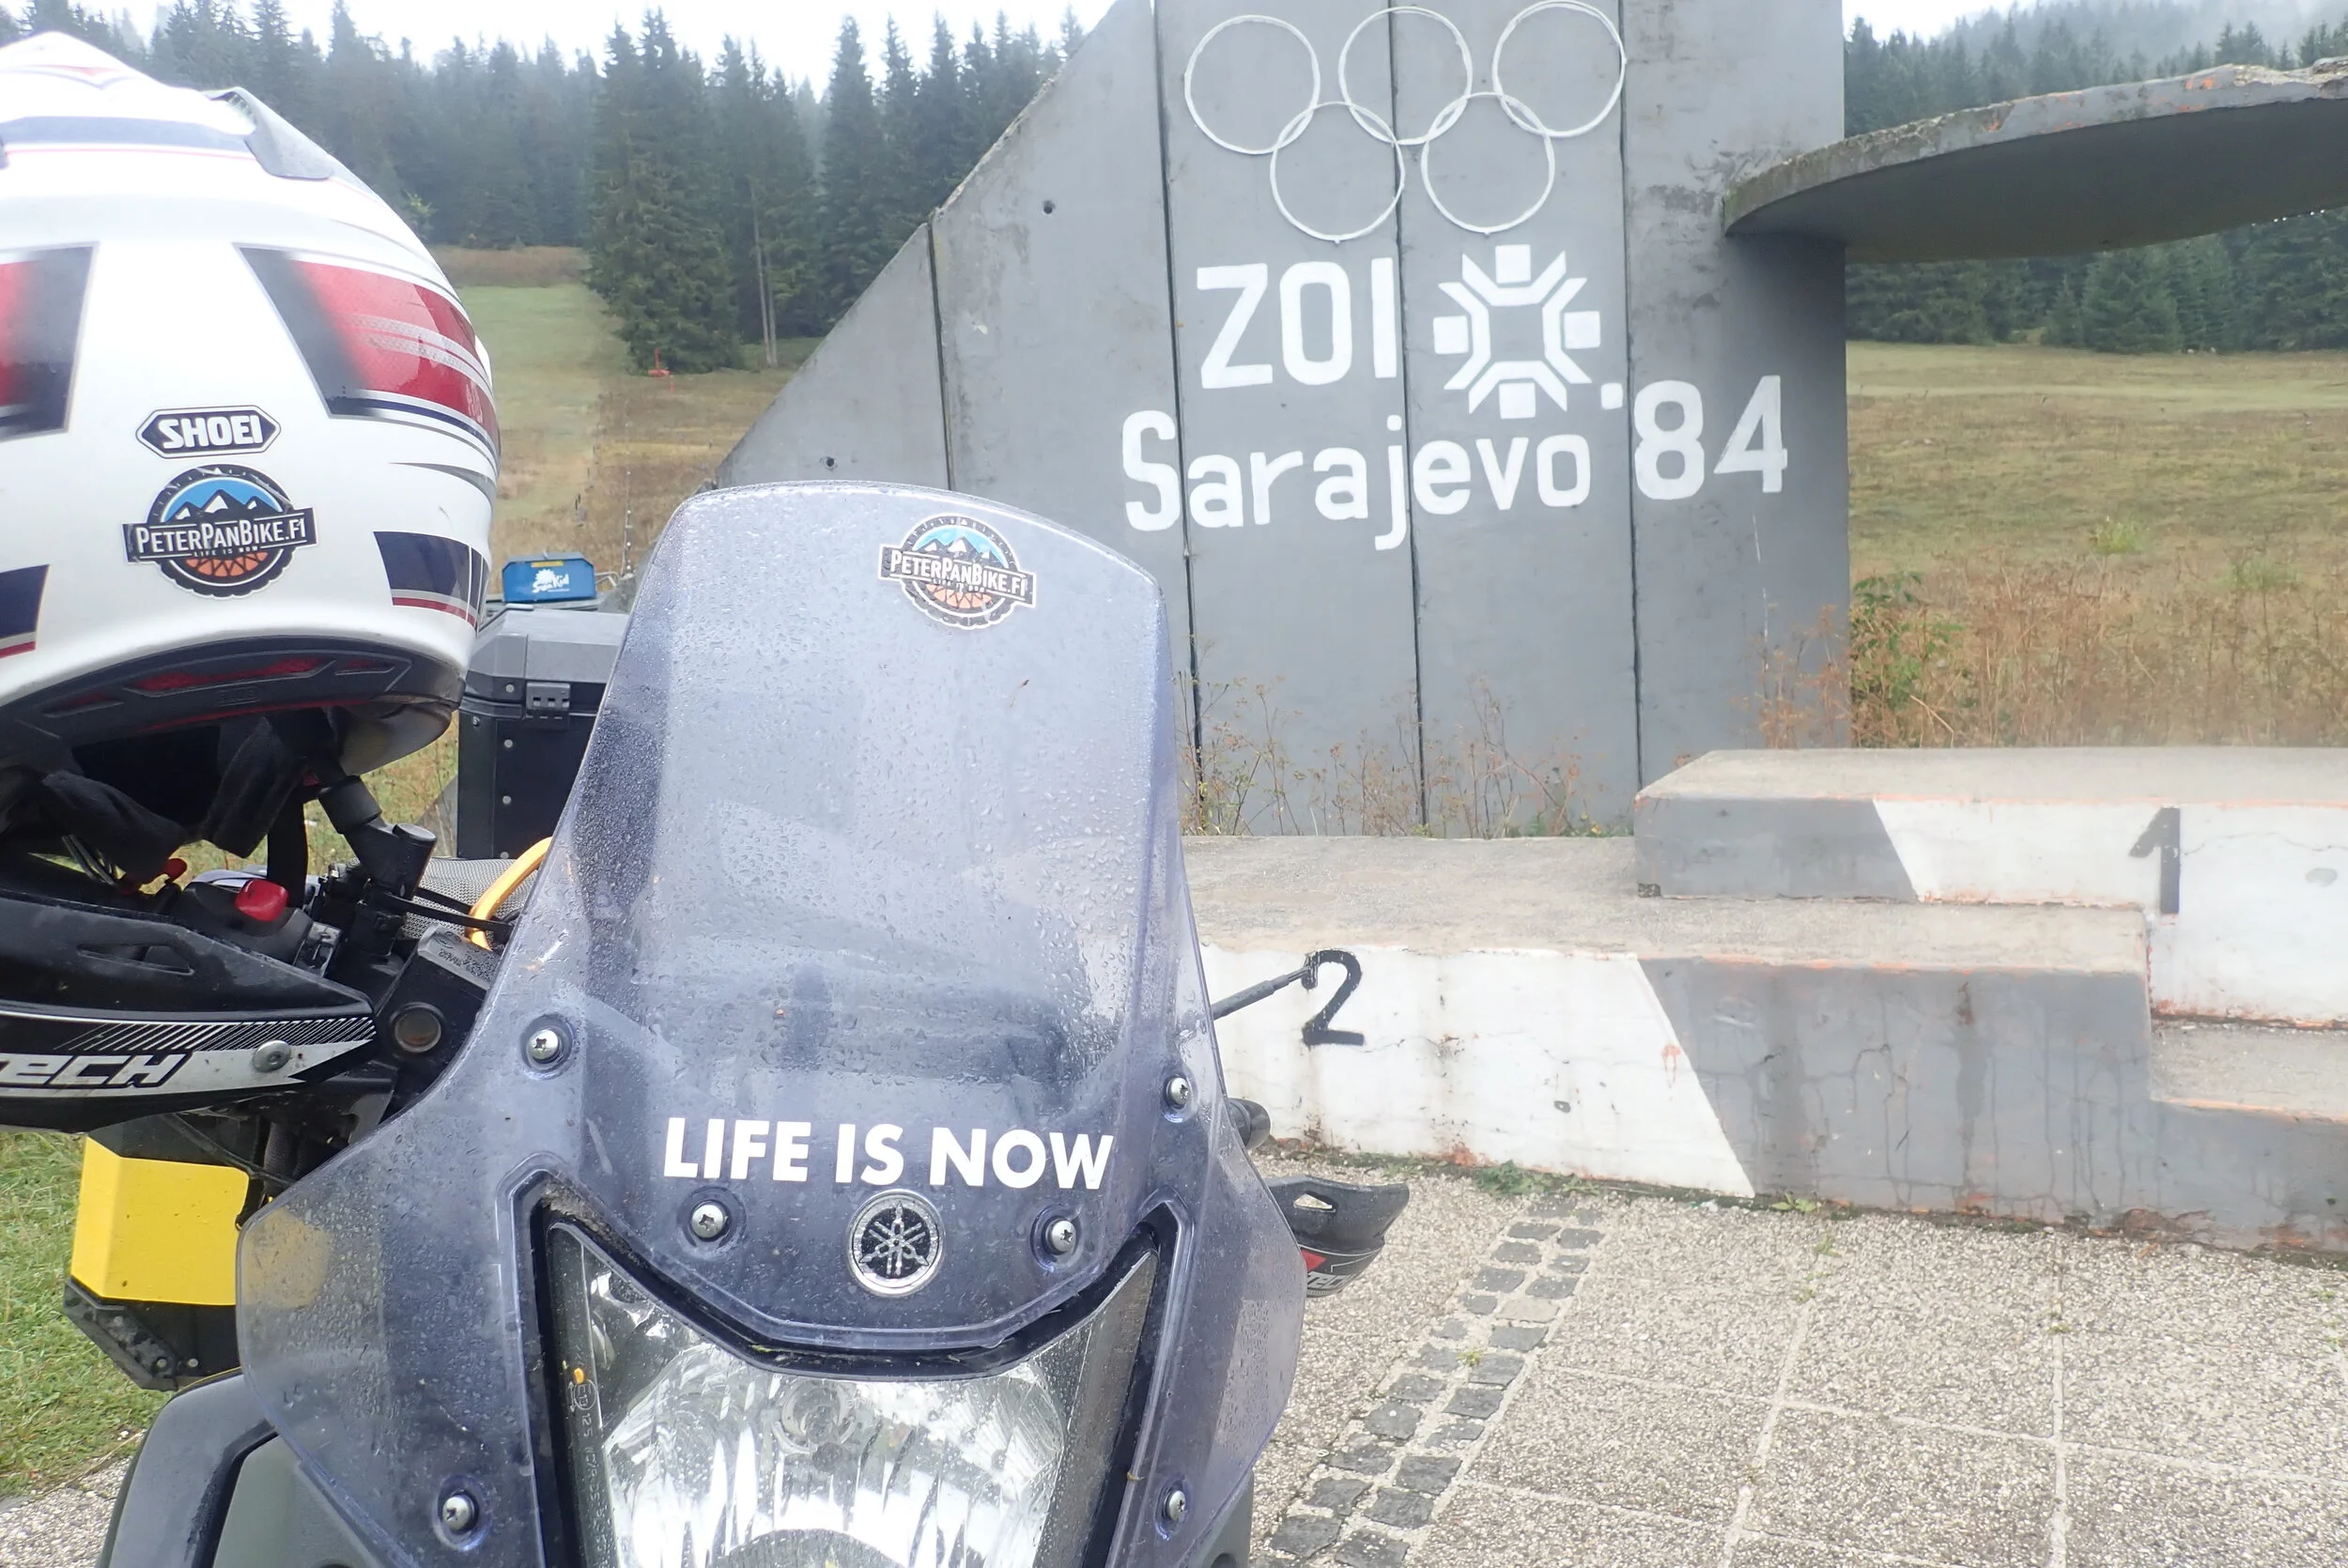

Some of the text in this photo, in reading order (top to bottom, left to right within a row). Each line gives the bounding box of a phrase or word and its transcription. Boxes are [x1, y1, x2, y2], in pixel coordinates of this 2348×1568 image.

[1197, 257, 1398, 389] ZOI
[158, 415, 263, 449] SHOEI
[1122, 410, 1591, 550] Sarajevo
[2128, 807, 2181, 915] 1
[1301, 949, 1365, 1047] 2
[663, 1117, 1114, 1190] LIFE IS NOW
